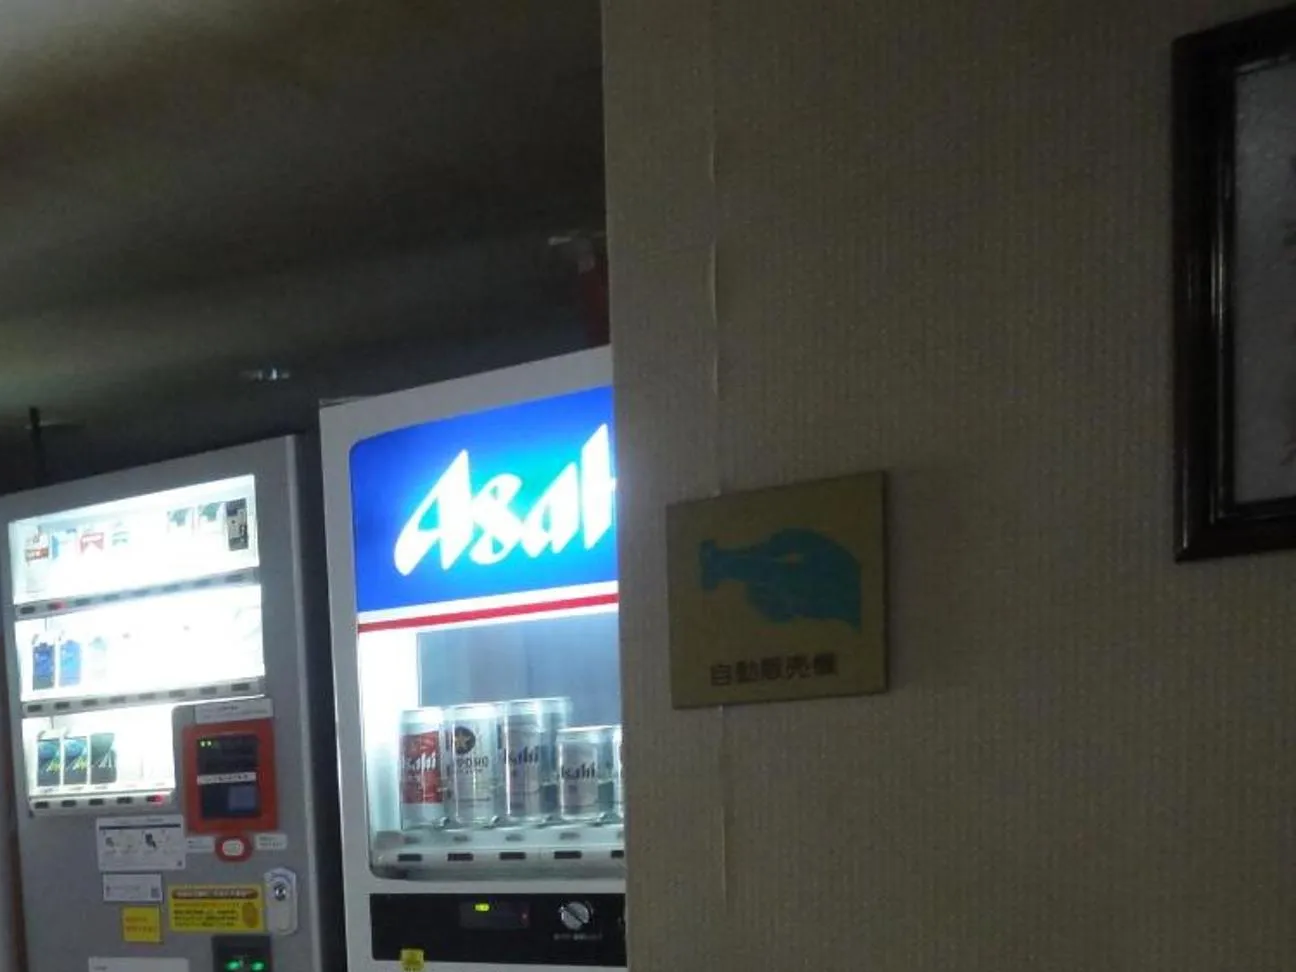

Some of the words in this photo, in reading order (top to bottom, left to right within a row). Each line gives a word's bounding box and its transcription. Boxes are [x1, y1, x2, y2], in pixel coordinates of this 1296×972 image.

[710, 652, 837, 686] 自動販売機
